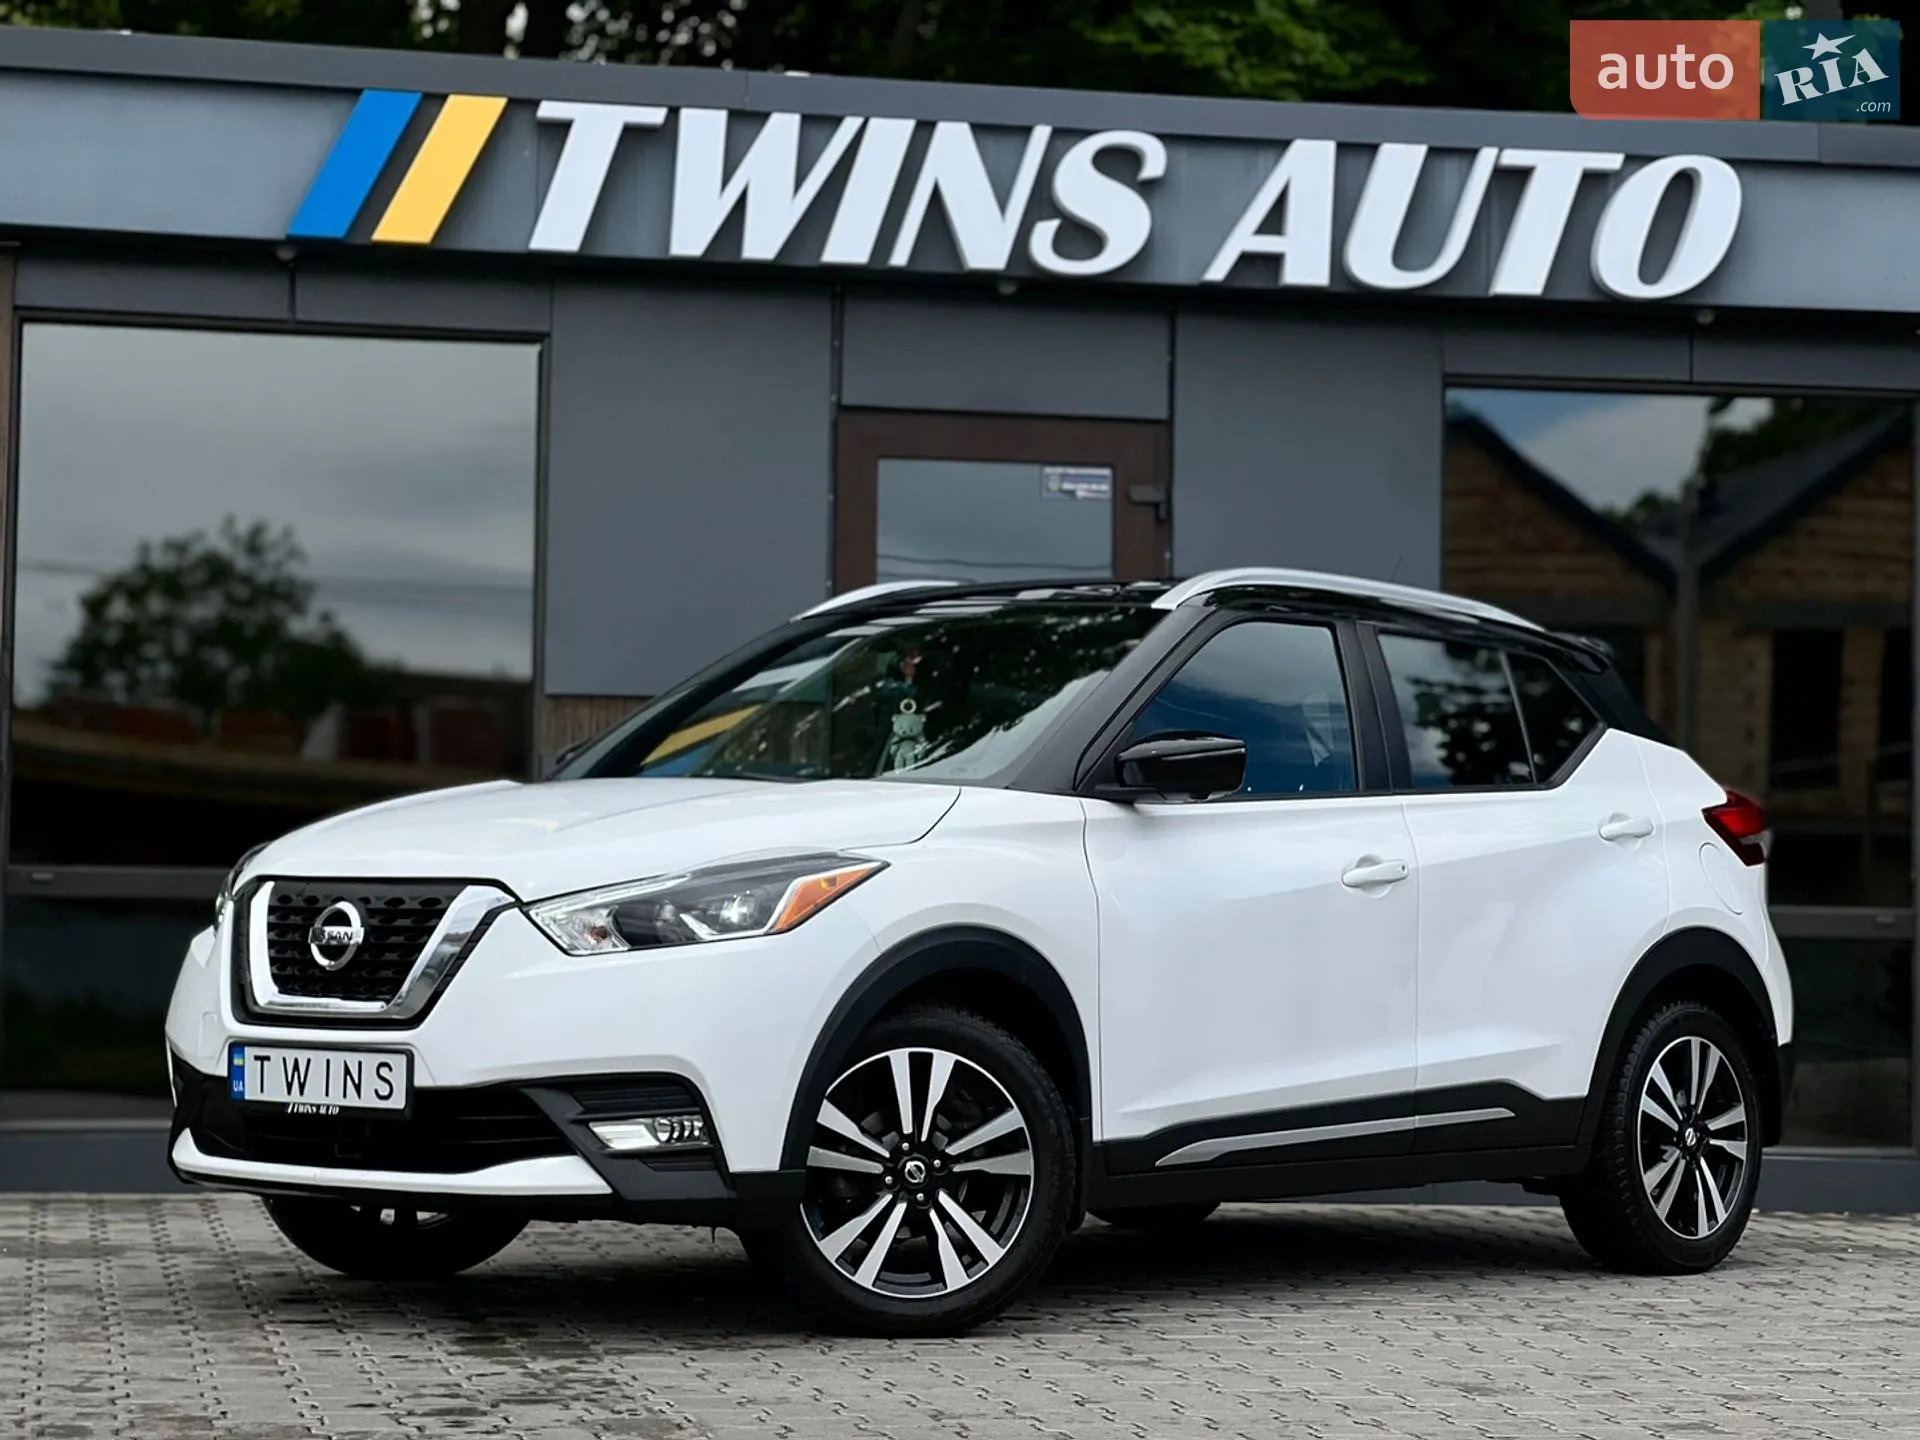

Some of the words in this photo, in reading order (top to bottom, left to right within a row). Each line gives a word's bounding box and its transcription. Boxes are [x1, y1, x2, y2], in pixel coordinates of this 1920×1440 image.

[528, 99, 1168, 276] TWINS
[1201, 138, 1743, 299] AUTO
[233, 1079, 244, 1092] UA
[253, 1055, 394, 1101] TWINS
